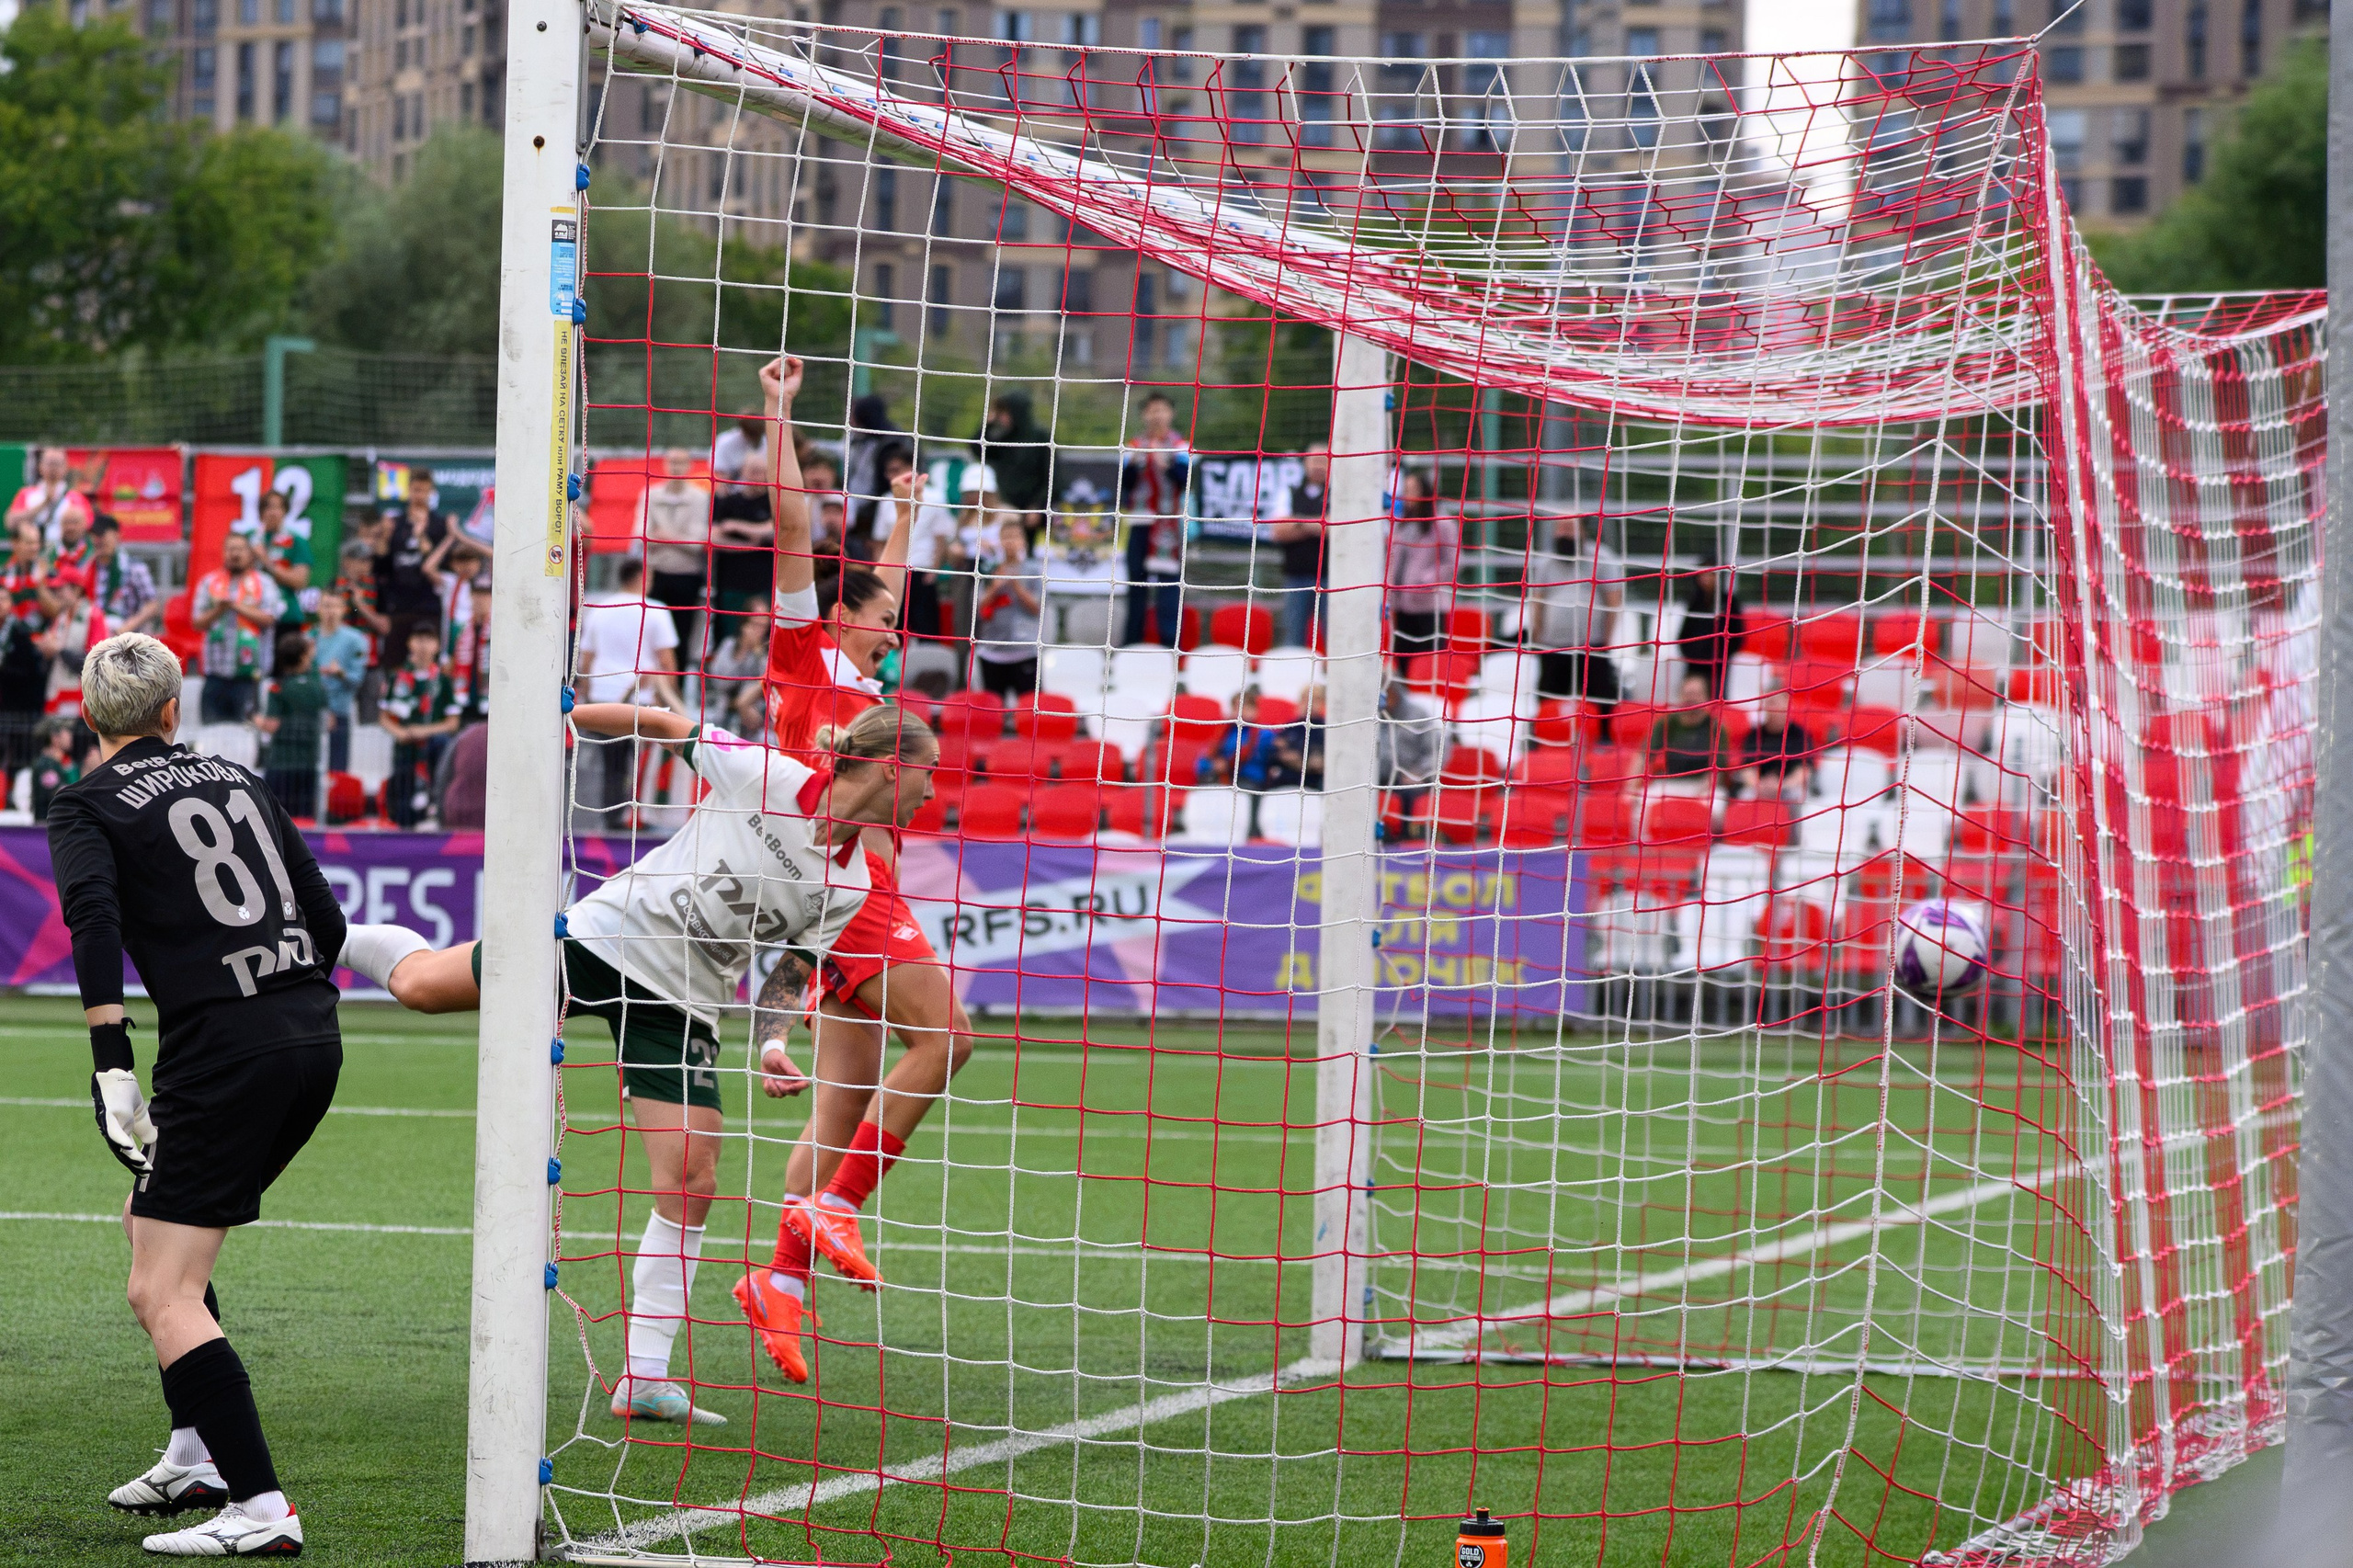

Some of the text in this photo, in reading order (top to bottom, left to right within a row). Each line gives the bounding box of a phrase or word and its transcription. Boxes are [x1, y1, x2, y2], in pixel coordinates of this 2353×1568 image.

[561, 332, 567, 345] НЕ
[560, 348, 568, 389] ВЛЕЗАЙ
[560, 392, 566, 406] НА
[231, 466, 313, 540] 12
[556, 468, 564, 495] РАМУ
[554, 499, 563, 535] ВОРОТ
[116, 760, 251, 810] ШИРОКОВА
[168, 790, 297, 926] 81
[747, 813, 802, 881] BetBoom
[690, 1038, 718, 1089] 2
